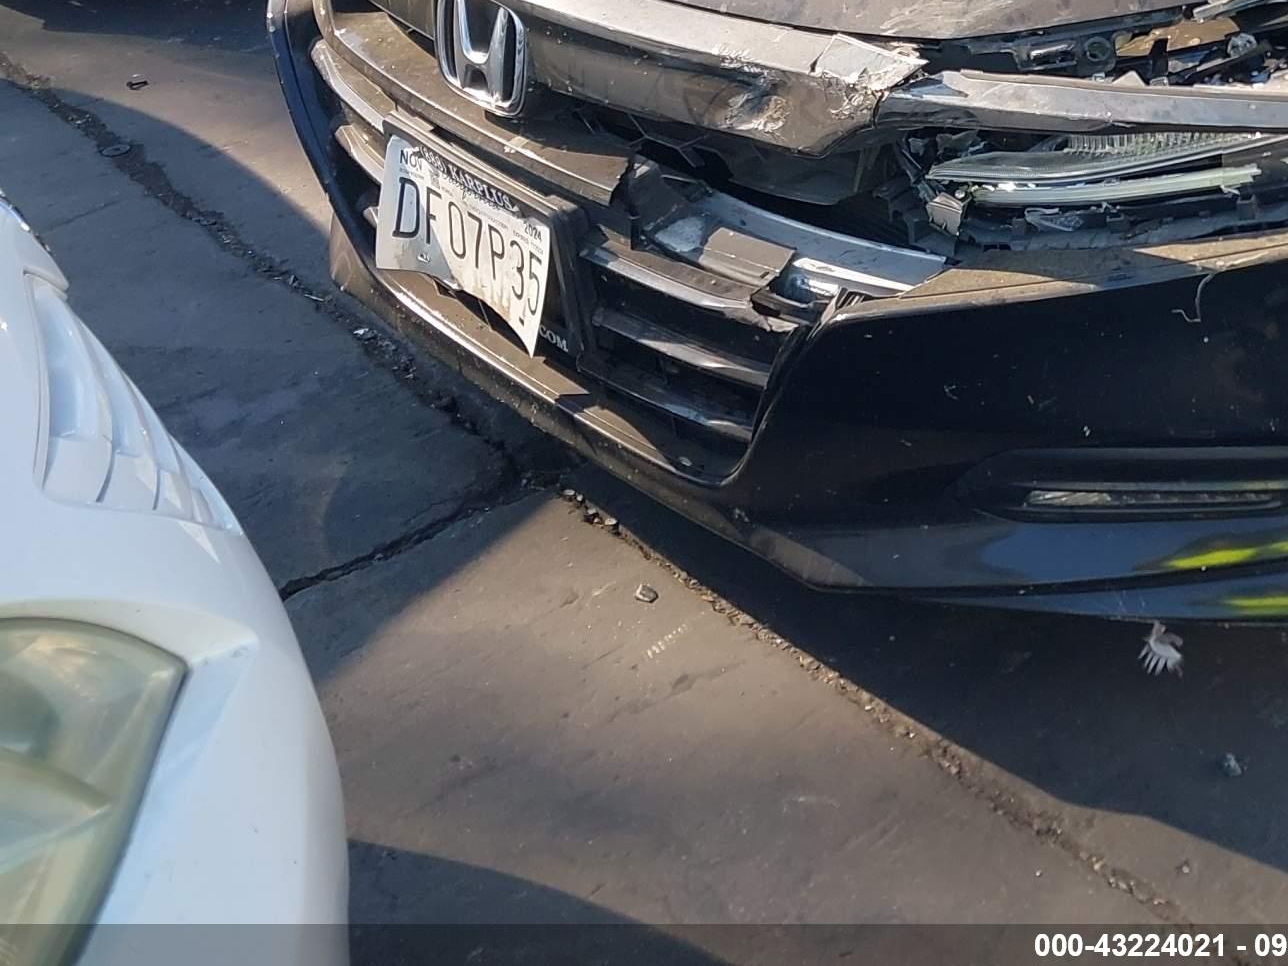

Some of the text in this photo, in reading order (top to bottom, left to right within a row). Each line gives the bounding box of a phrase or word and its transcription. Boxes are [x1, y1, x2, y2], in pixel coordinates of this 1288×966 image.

[399, 149, 424, 172] NOV
[448, 164, 513, 212] KARPLUS
[392, 177, 543, 316] DF07P35
[524, 222, 543, 242] 2024
